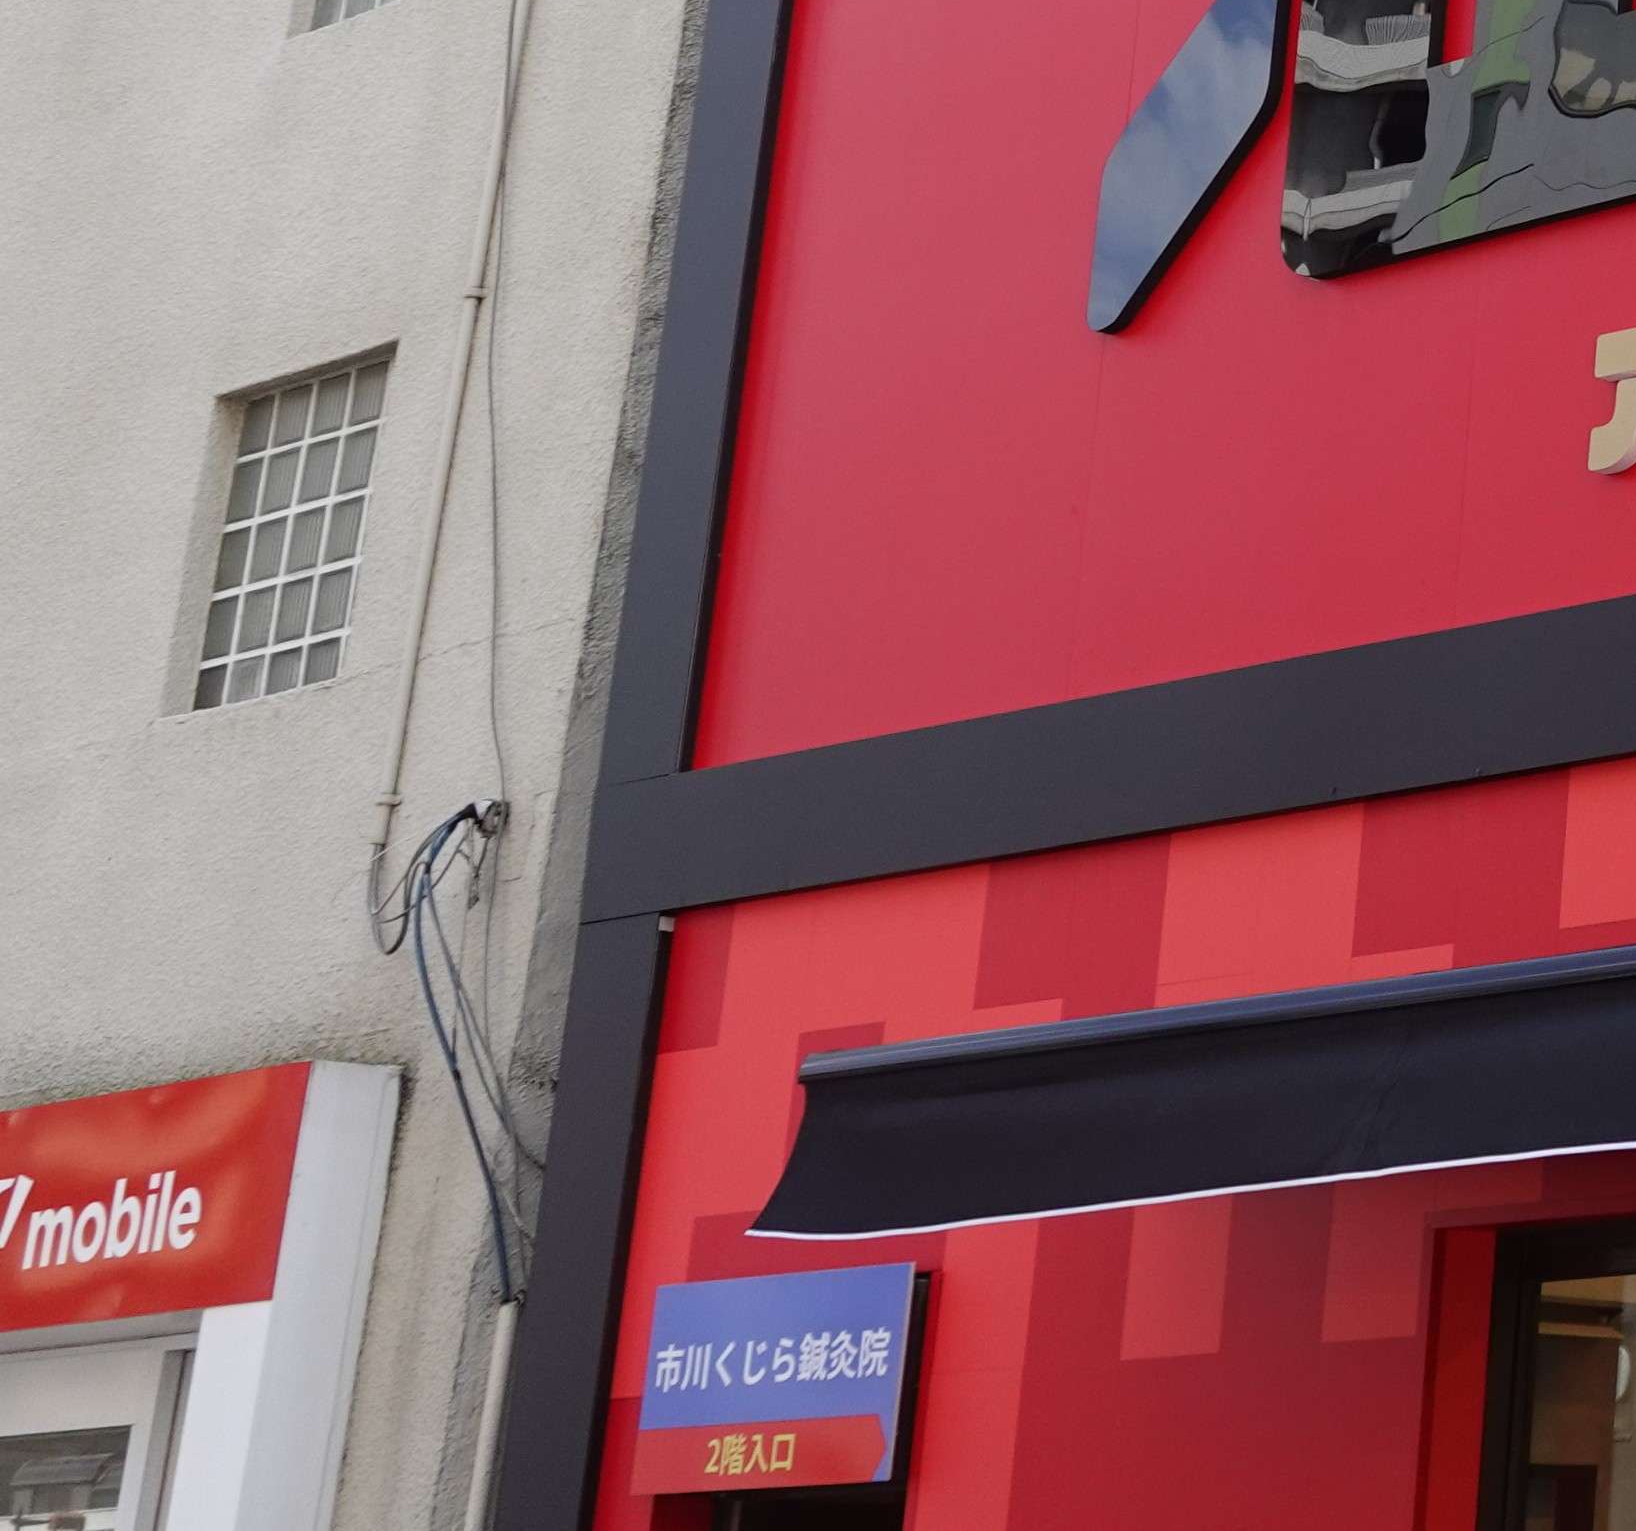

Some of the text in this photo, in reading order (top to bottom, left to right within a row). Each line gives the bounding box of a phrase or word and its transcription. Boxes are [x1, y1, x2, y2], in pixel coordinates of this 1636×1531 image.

[655, 1327, 891, 1393] 市川くじら鍼灸院
[704, 1433, 796, 1477] 2階入口
